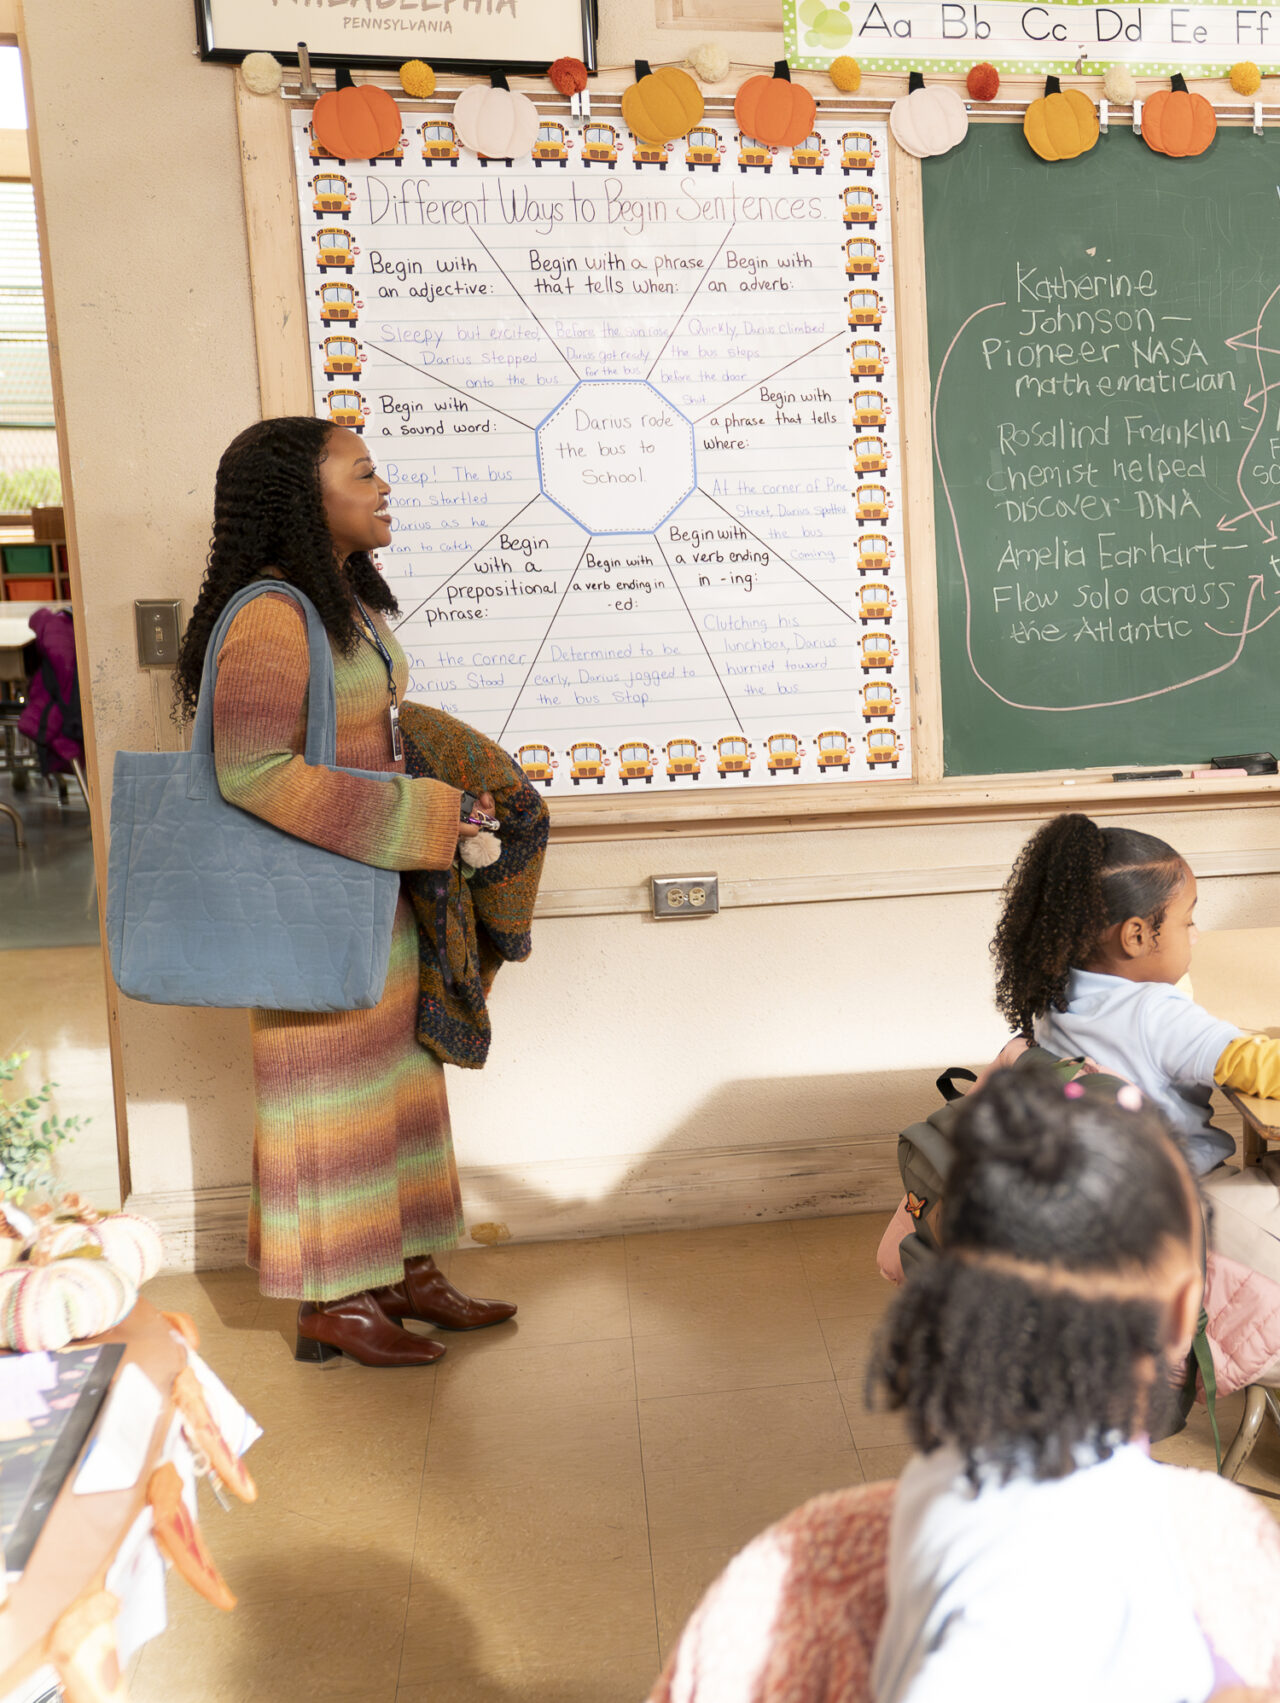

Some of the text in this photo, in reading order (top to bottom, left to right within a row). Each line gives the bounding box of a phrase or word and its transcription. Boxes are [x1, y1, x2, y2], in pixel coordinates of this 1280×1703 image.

[343, 16, 452, 34] PENNSYLVANIA
[858, 2, 912, 39] Aa
[941, 4, 992, 39] Bb
[1021, 6, 1067, 42] Cc
[1096, 7, 1143, 43] Dd
[1170, 8, 1208, 45] Ee
[1236, 10, 1272, 46] Ff
[367, 175, 827, 236] Different Ways to Begin Sentences.
[370, 251, 478, 281] Begin with
[529, 250, 704, 280] Begin with phrase
[726, 250, 813, 275] Begin with
[409, 282, 495, 302] adjective:
[588, 276, 679, 294] tells when:
[740, 275, 794, 292] adverb:
[1016, 260, 1158, 304] Katherine
[381, 324, 444, 349] Sleepy
[982, 336, 1208, 370] Pioneer NASA
[1015, 369, 1236, 398] mathematician
[401, 420, 497, 436] sound word:
[575, 408, 674, 432] Darius rode
[703, 436, 749, 450] where:
[997, 415, 1230, 456] Rosalind Franklin
[387, 463, 479, 488] Beep! The
[1112, 452, 1206, 484] helped
[1134, 488, 1201, 520] DNA
[586, 553, 621, 573] Begin
[996, 536, 1086, 573] Amelia
[446, 579, 557, 605] prepositional
[992, 582, 1058, 612] Flew
[1140, 582, 1236, 610] across
[703, 613, 800, 633] Clutching his
[1010, 616, 1192, 644] the Atlantic
[727, 658, 775, 676] hurried
